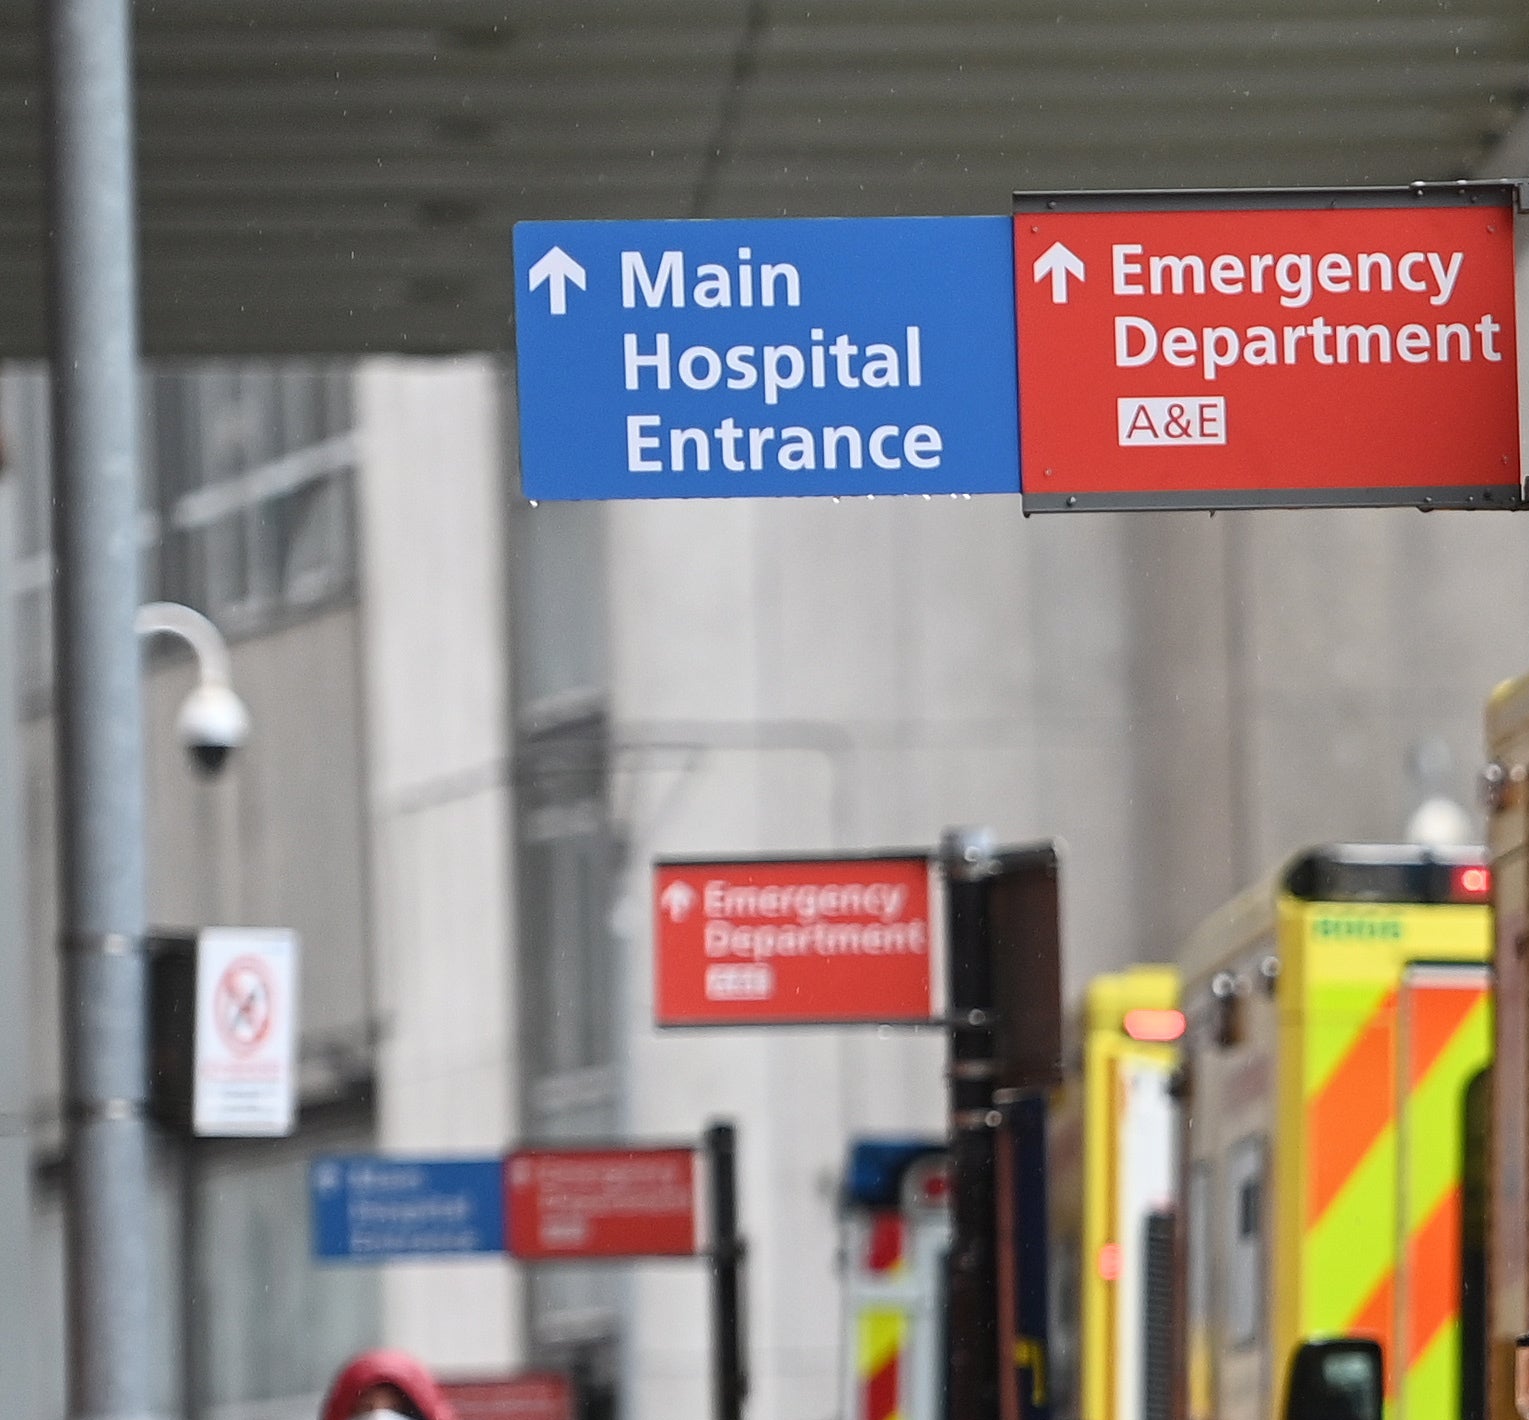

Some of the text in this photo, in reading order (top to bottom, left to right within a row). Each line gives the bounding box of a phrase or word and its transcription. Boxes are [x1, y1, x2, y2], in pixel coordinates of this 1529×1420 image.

[619, 246, 801, 310] Main
[1110, 242, 1464, 308] Emergency
[622, 325, 923, 406] Hospital
[1113, 314, 1503, 382] Department
[628, 413, 943, 472] Entrance
[1123, 402, 1222, 441] A&E
[704, 879, 909, 924] Emergency
[704, 918, 928, 961] Department
